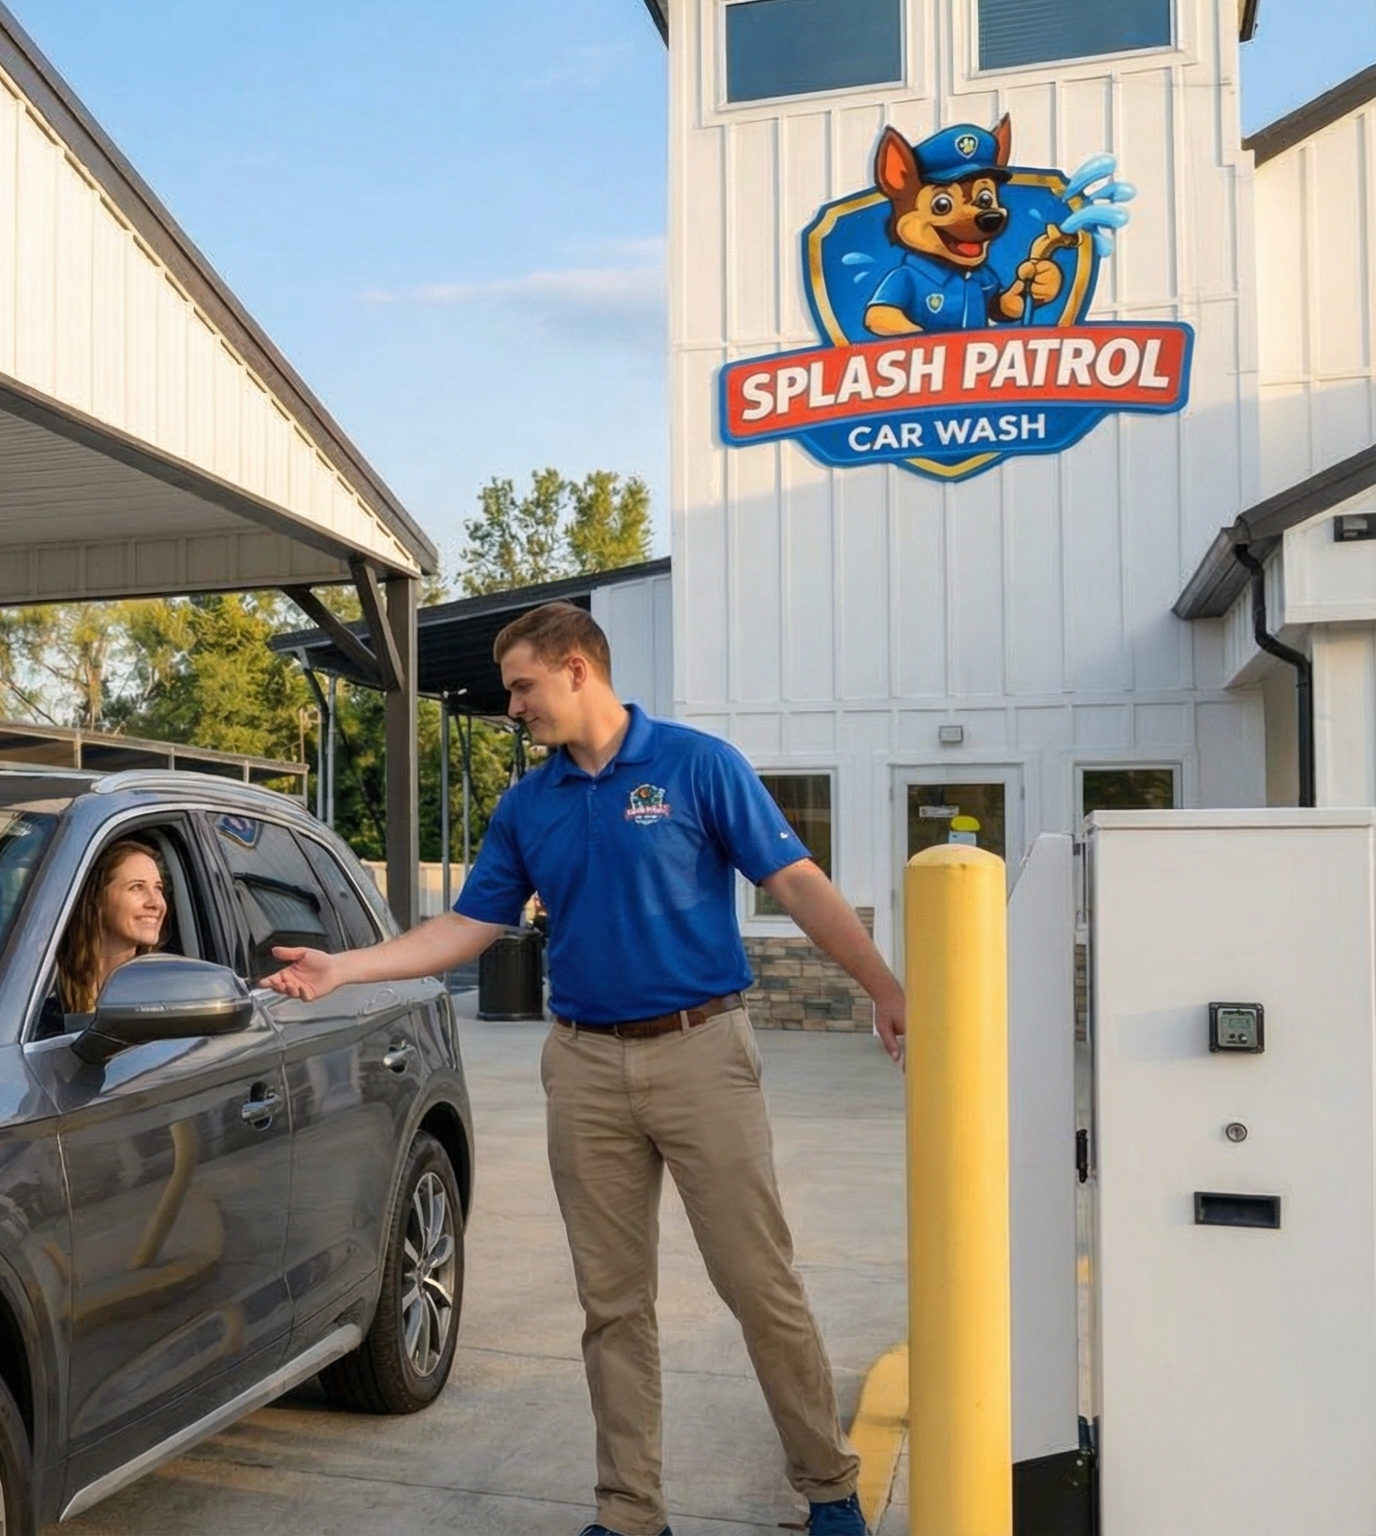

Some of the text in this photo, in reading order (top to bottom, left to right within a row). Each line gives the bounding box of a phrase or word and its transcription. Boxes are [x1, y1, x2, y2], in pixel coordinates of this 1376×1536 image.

[741, 338, 1170, 420] SPLASH PATROL
[848, 412, 1046, 451] CAR WASH
